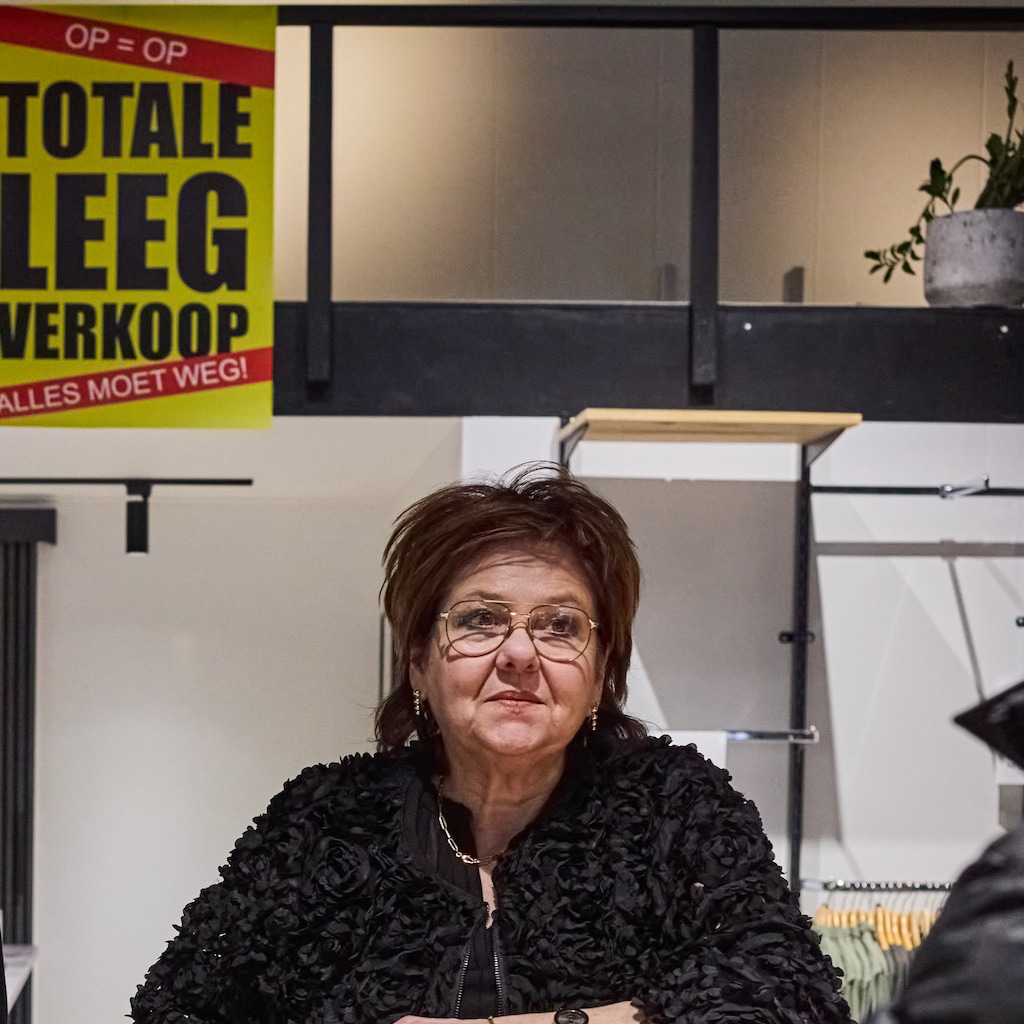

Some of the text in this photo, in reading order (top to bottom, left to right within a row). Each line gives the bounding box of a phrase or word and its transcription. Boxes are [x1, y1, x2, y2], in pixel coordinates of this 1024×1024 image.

[65, 24, 188, 65] OP = OP
[0, 171, 248, 293] LEEG
[89, 369, 166, 401] MOET
[173, 357, 248, 387] WEG!
